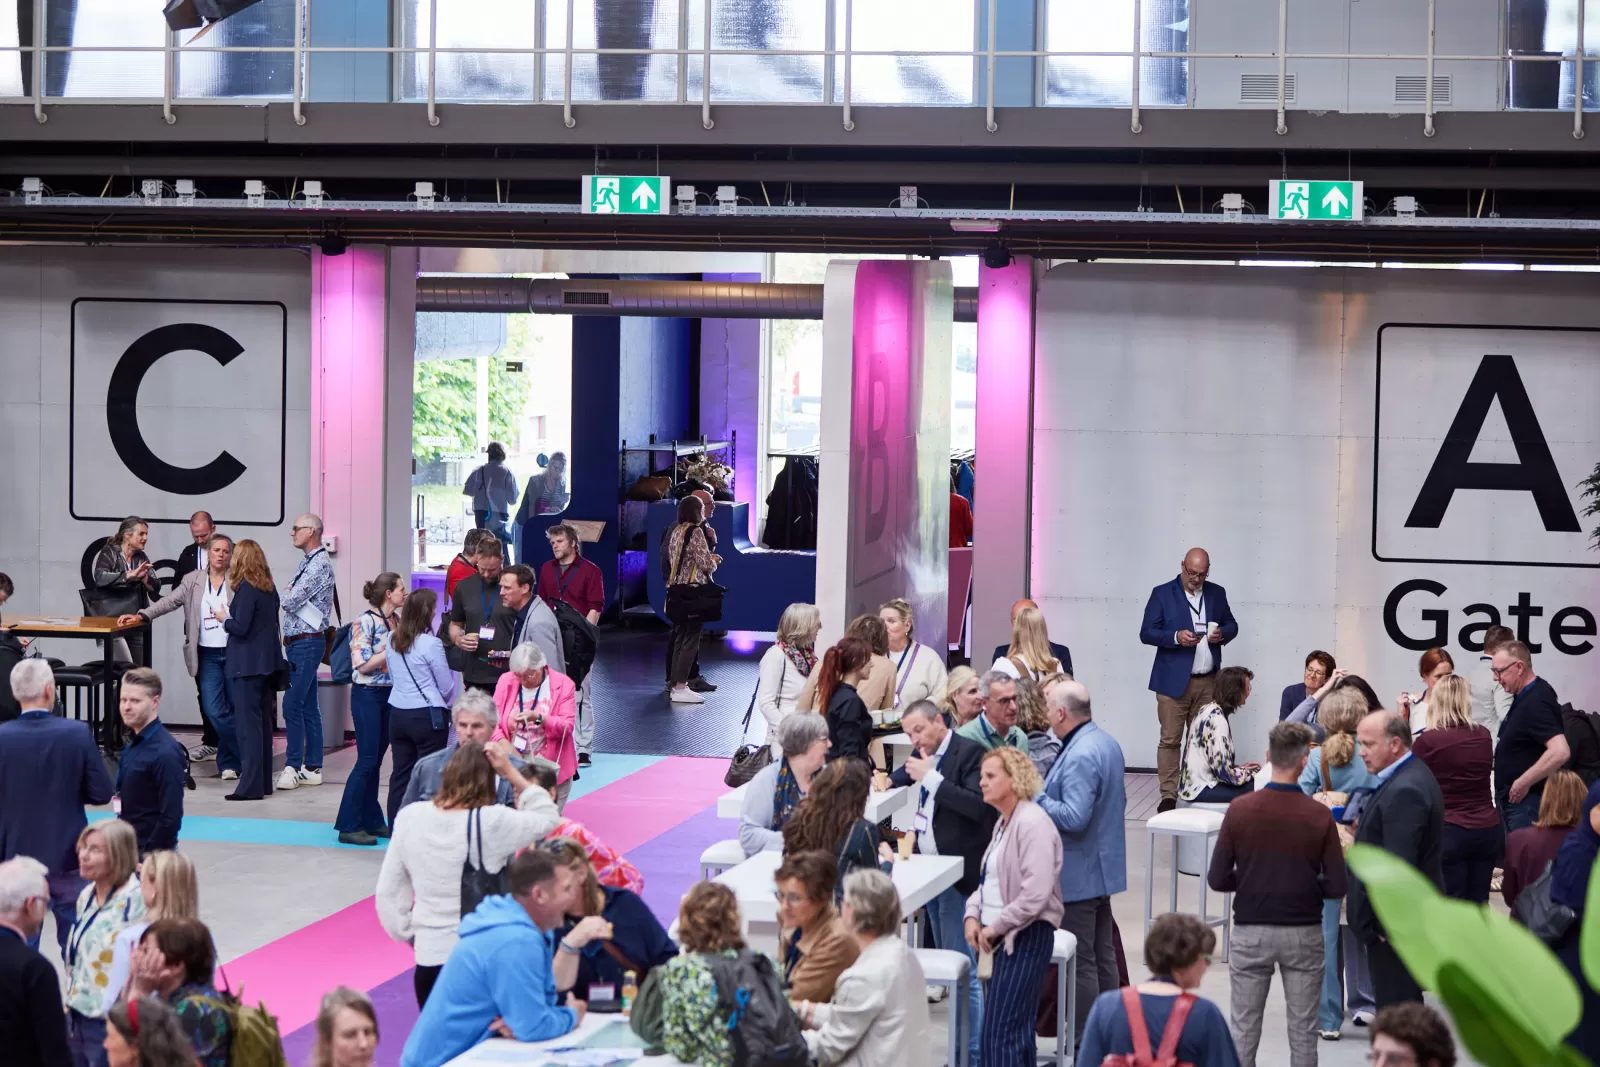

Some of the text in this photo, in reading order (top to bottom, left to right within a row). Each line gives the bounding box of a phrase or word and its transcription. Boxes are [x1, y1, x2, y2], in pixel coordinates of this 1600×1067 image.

[107, 323, 247, 495] C
[865, 351, 891, 546] B
[1404, 355, 1582, 532] A
[1383, 578, 1597, 656] Gate
